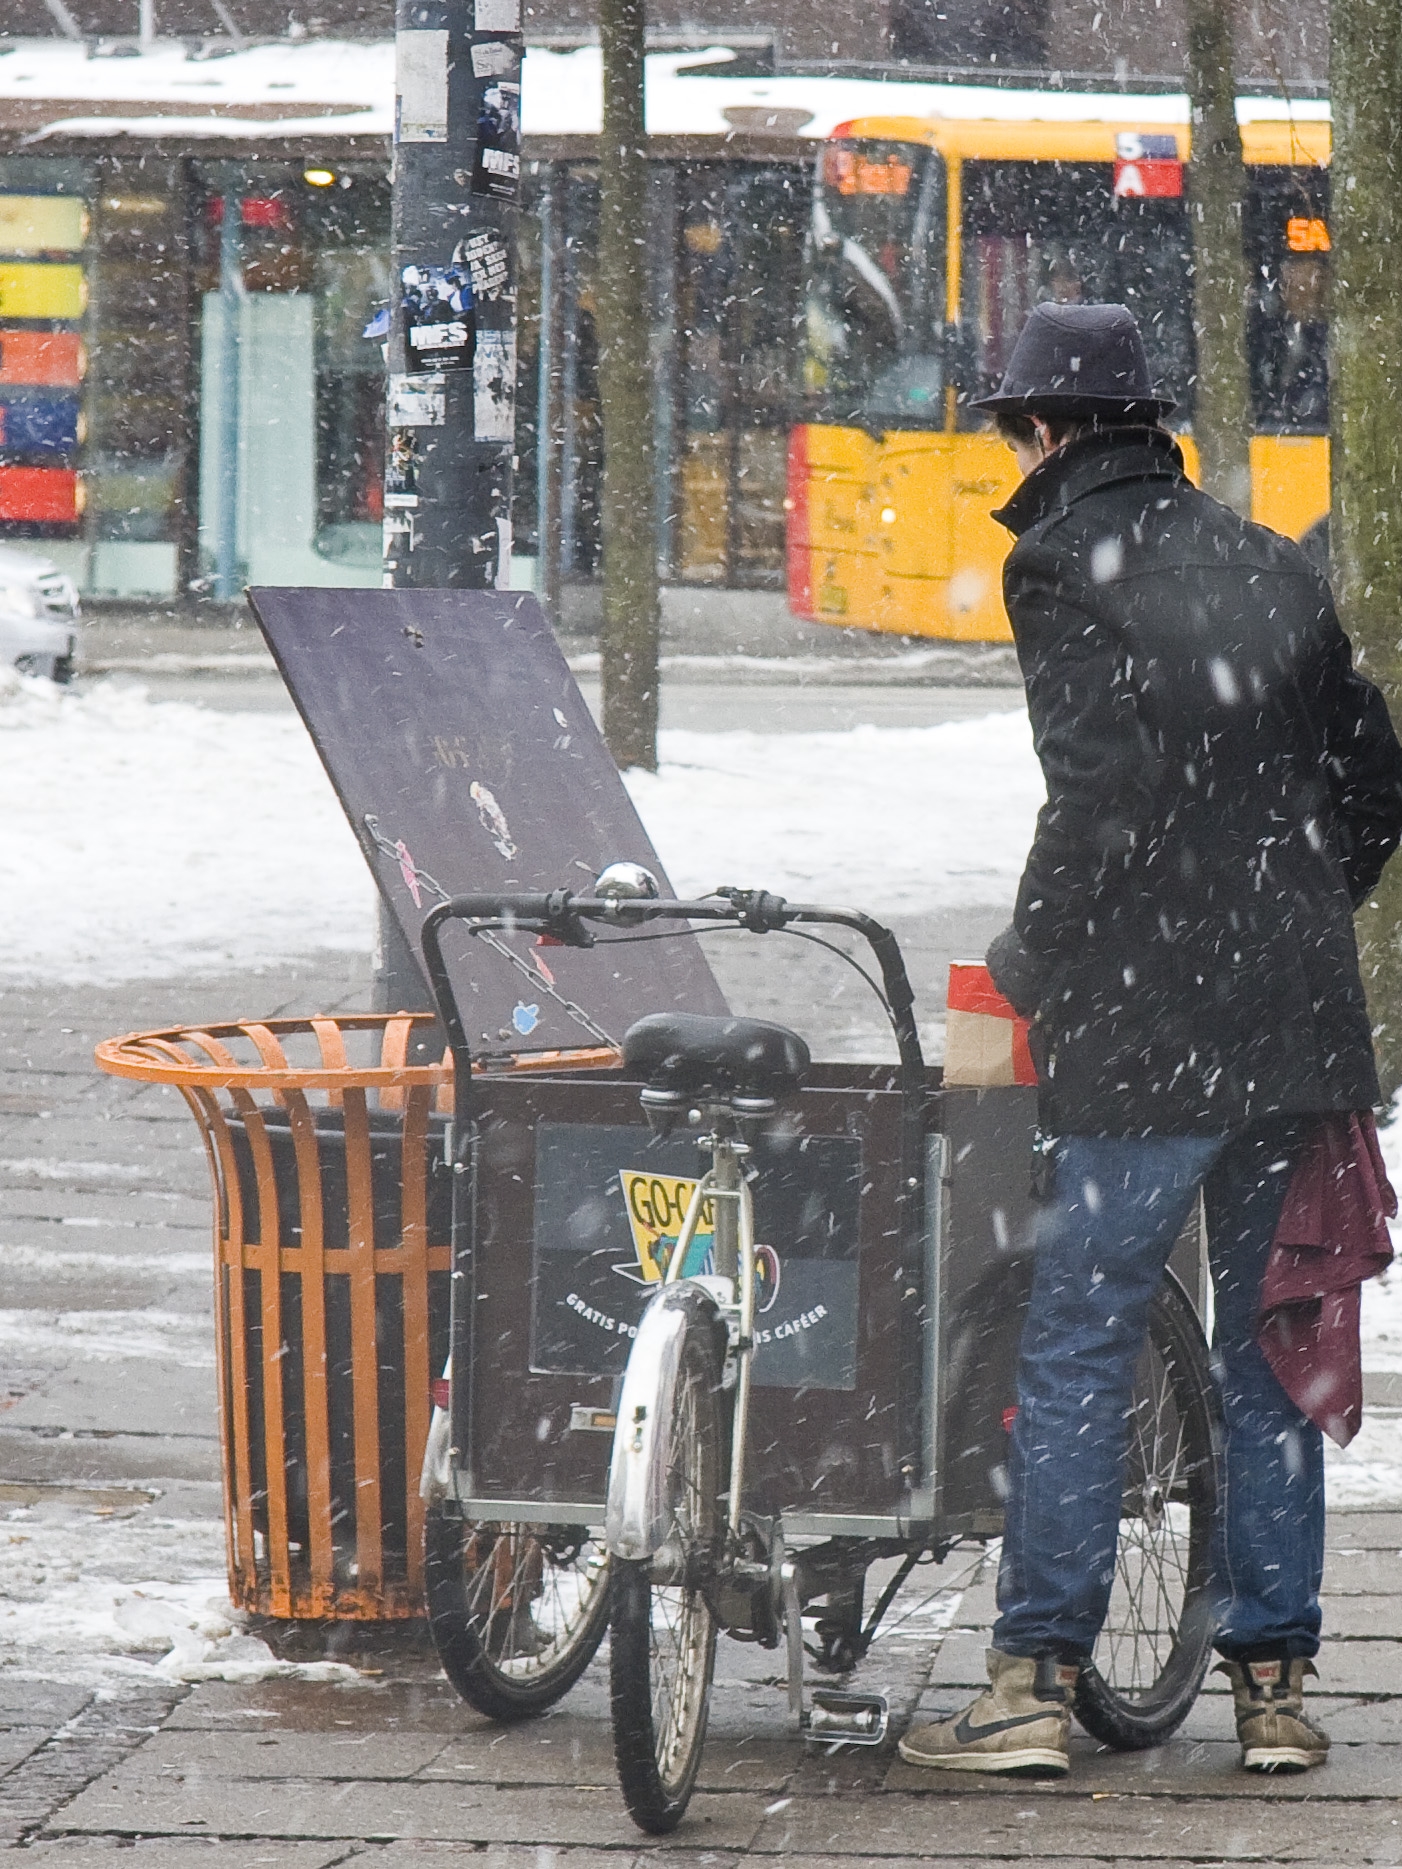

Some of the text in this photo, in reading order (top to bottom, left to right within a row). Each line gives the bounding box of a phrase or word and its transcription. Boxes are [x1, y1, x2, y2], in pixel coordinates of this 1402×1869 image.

[1117, 132, 1143, 160] 5
[1115, 165, 1145, 197] A
[1287, 217, 1331, 252] 5A
[566, 1293, 616, 1331] GRATIS
[774, 1304, 829, 1340] CAFÉER
